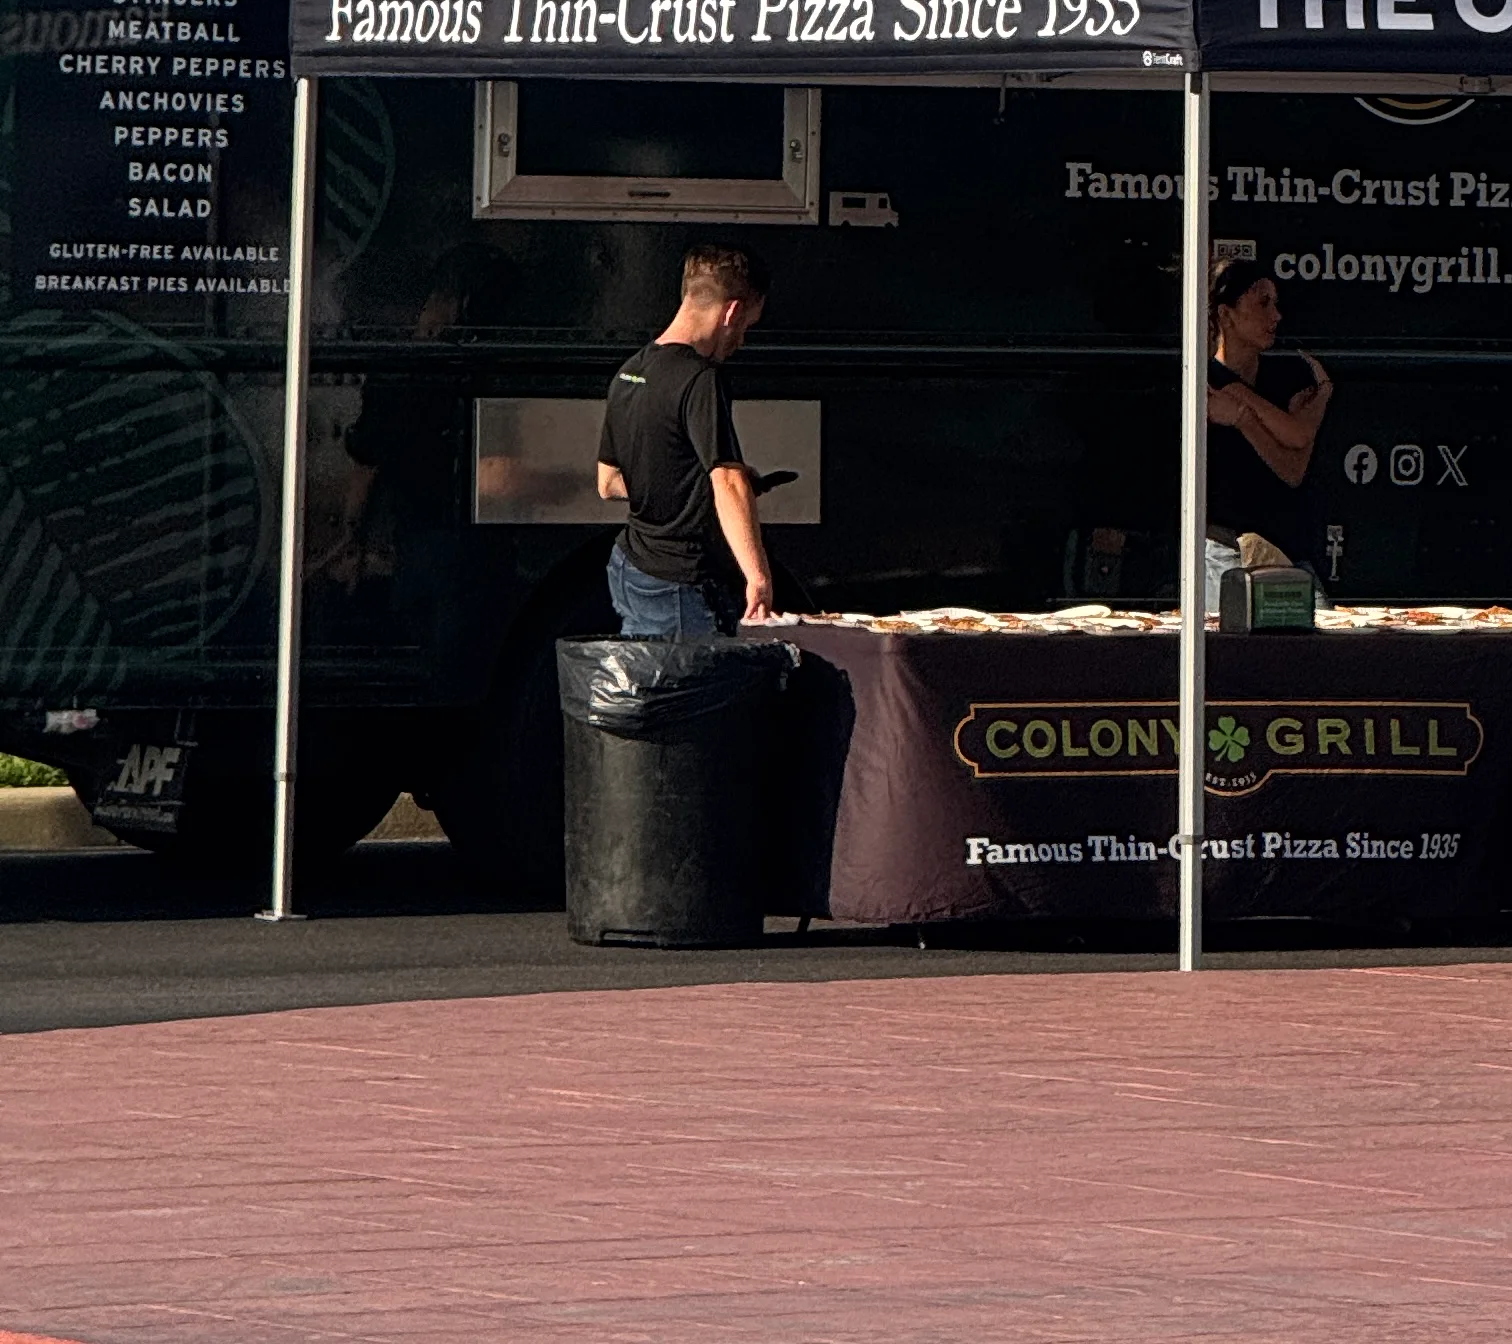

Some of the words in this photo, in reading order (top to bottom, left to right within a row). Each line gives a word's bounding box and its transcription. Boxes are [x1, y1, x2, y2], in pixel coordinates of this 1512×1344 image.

[108, 20, 240, 45] MEATBALL
[59, 54, 160, 75] CHERRY
[172, 57, 285, 78] PEPPERS
[100, 91, 244, 113] ANCHOVIES
[115, 126, 228, 148] PEPPERS
[129, 162, 212, 182] BACON
[1227, 166, 1440, 206] Thin-Crust
[129, 198, 211, 218] SALAD
[49, 243, 174, 260] GLUTEN-FREE
[181, 246, 279, 263] AVAILABLE
[35, 275, 140, 291] BREAKFAST
[148, 277, 188, 292] PIES
[1266, 718, 1457, 756] GRILL
[966, 838, 1082, 865] Famous
[1261, 832, 1339, 858] Pizza
[1346, 832, 1413, 859] Since
[1419, 833, 1460, 859] 1935
